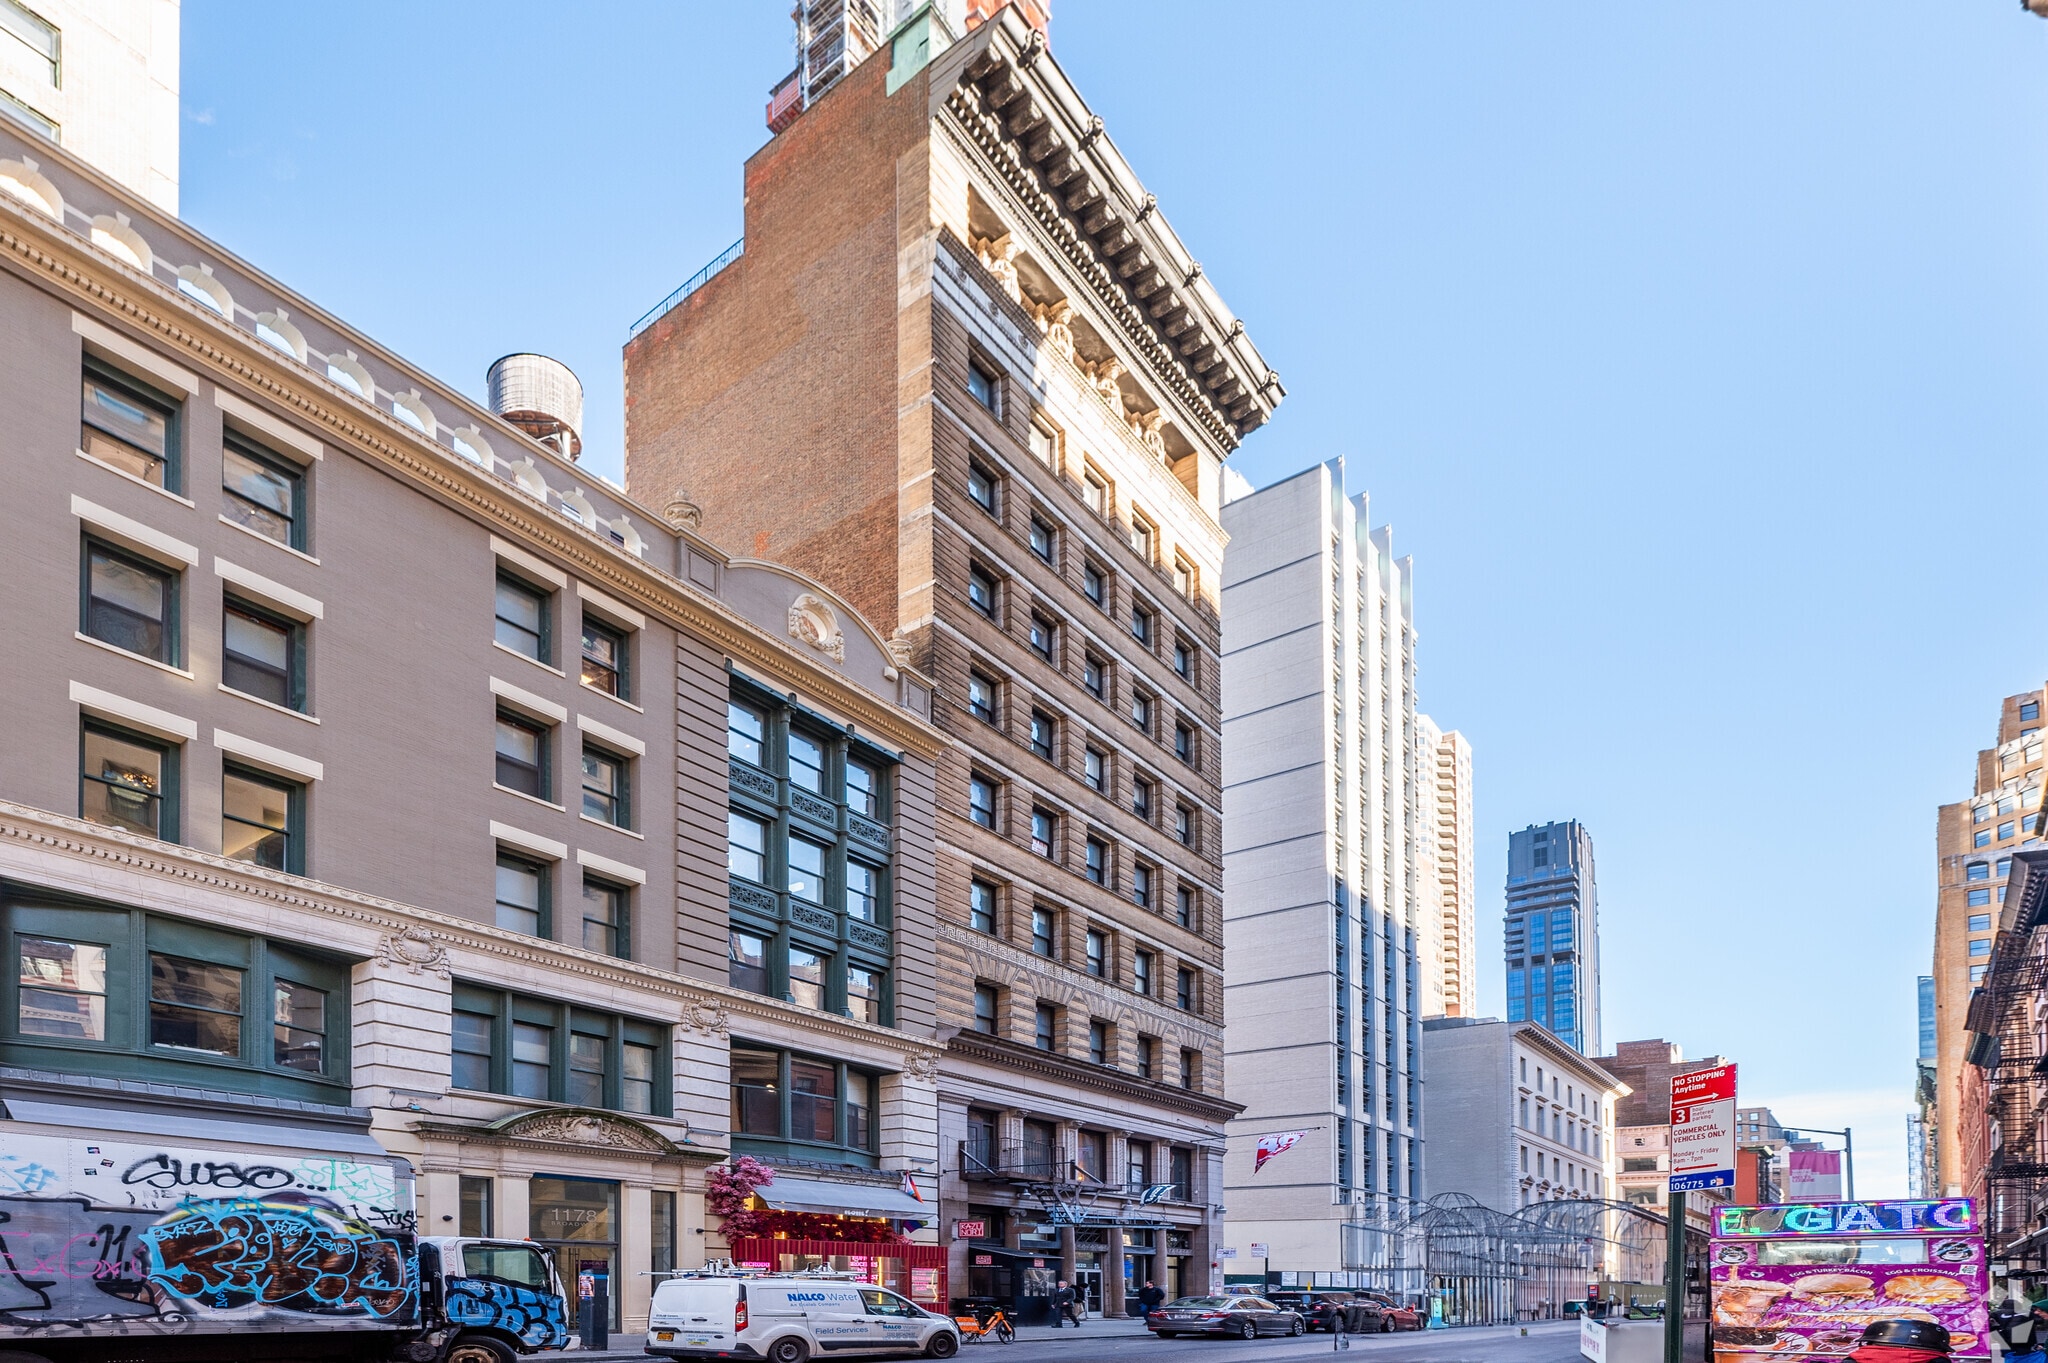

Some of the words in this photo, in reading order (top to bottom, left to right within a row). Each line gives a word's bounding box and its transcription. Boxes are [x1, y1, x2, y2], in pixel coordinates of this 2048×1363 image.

[1674, 1078, 1685, 1087] NO
[1687, 1070, 1725, 1084] STOPPING
[1674, 1082, 1706, 1095] Anytime
[1675, 1109, 1686, 1124] 3
[1692, 1108, 1714, 1118] metered
[1692, 1114, 1712, 1122] parking
[1673, 1123, 1718, 1137] COMMERCIAL
[1673, 1132, 1706, 1144] VEHICLES
[1708, 1130, 1727, 1140] ONLY
[1673, 1149, 1695, 1159] Monday
[1700, 1147, 1720, 1157] Friday
[1669, 1180, 1704, 1191] 106775
[551, 1208, 597, 1223] 1178
[1789, 1269, 1806, 1278] EGG
[1844, 1267, 1873, 1276] BACON
[1885, 1269, 1903, 1277] EGG
[1911, 1267, 1960, 1278] CROISSANT
[787, 1293, 826, 1302] NALCO
[826, 1292, 858, 1302] Water
[815, 1327, 835, 1336] Field
[836, 1325, 869, 1335] Services
